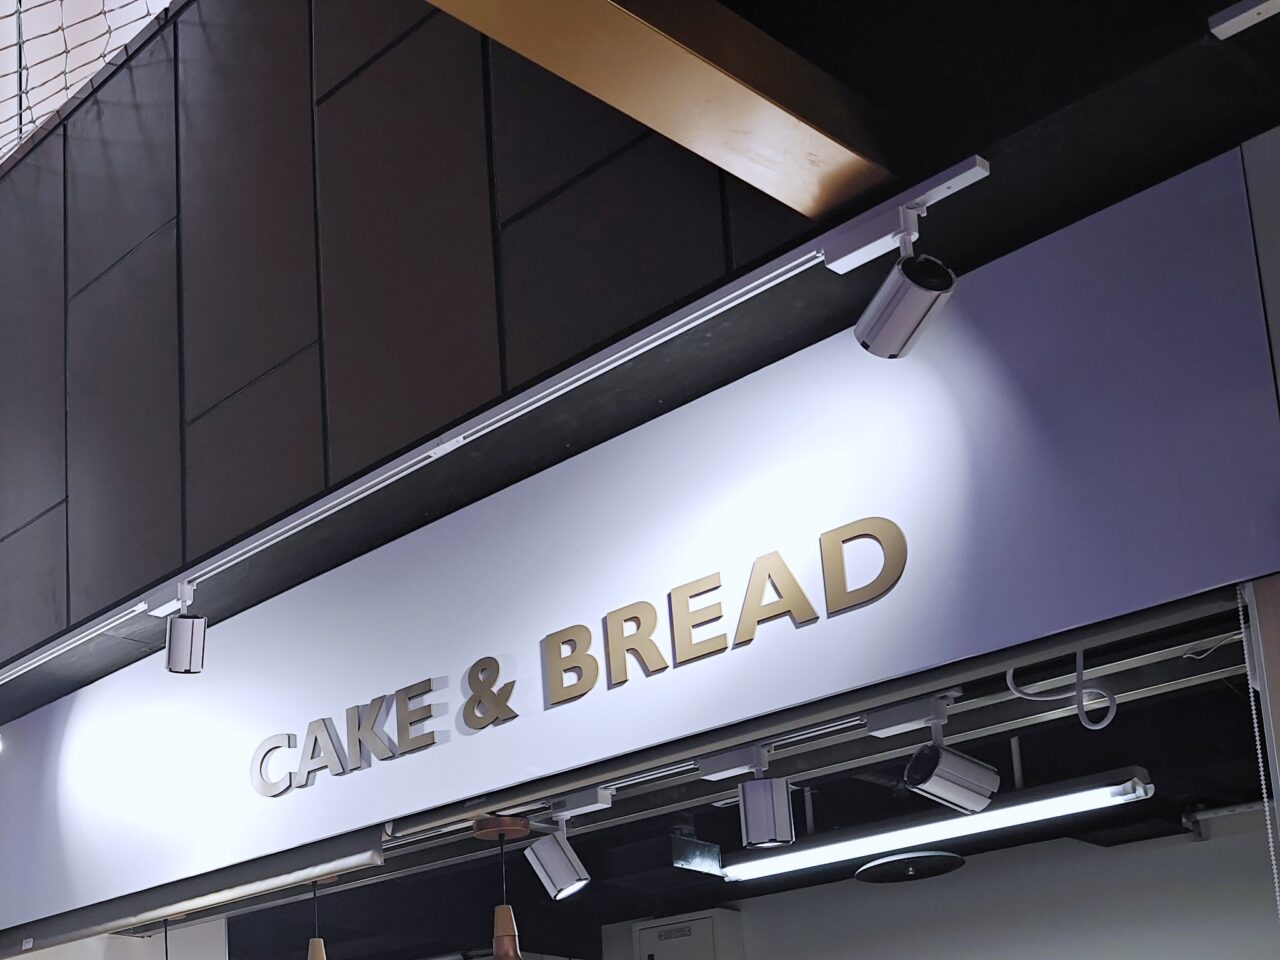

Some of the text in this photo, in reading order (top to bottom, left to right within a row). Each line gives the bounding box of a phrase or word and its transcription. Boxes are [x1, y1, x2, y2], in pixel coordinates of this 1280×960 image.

[250, 516, 908, 798] CAKE & BREAD
